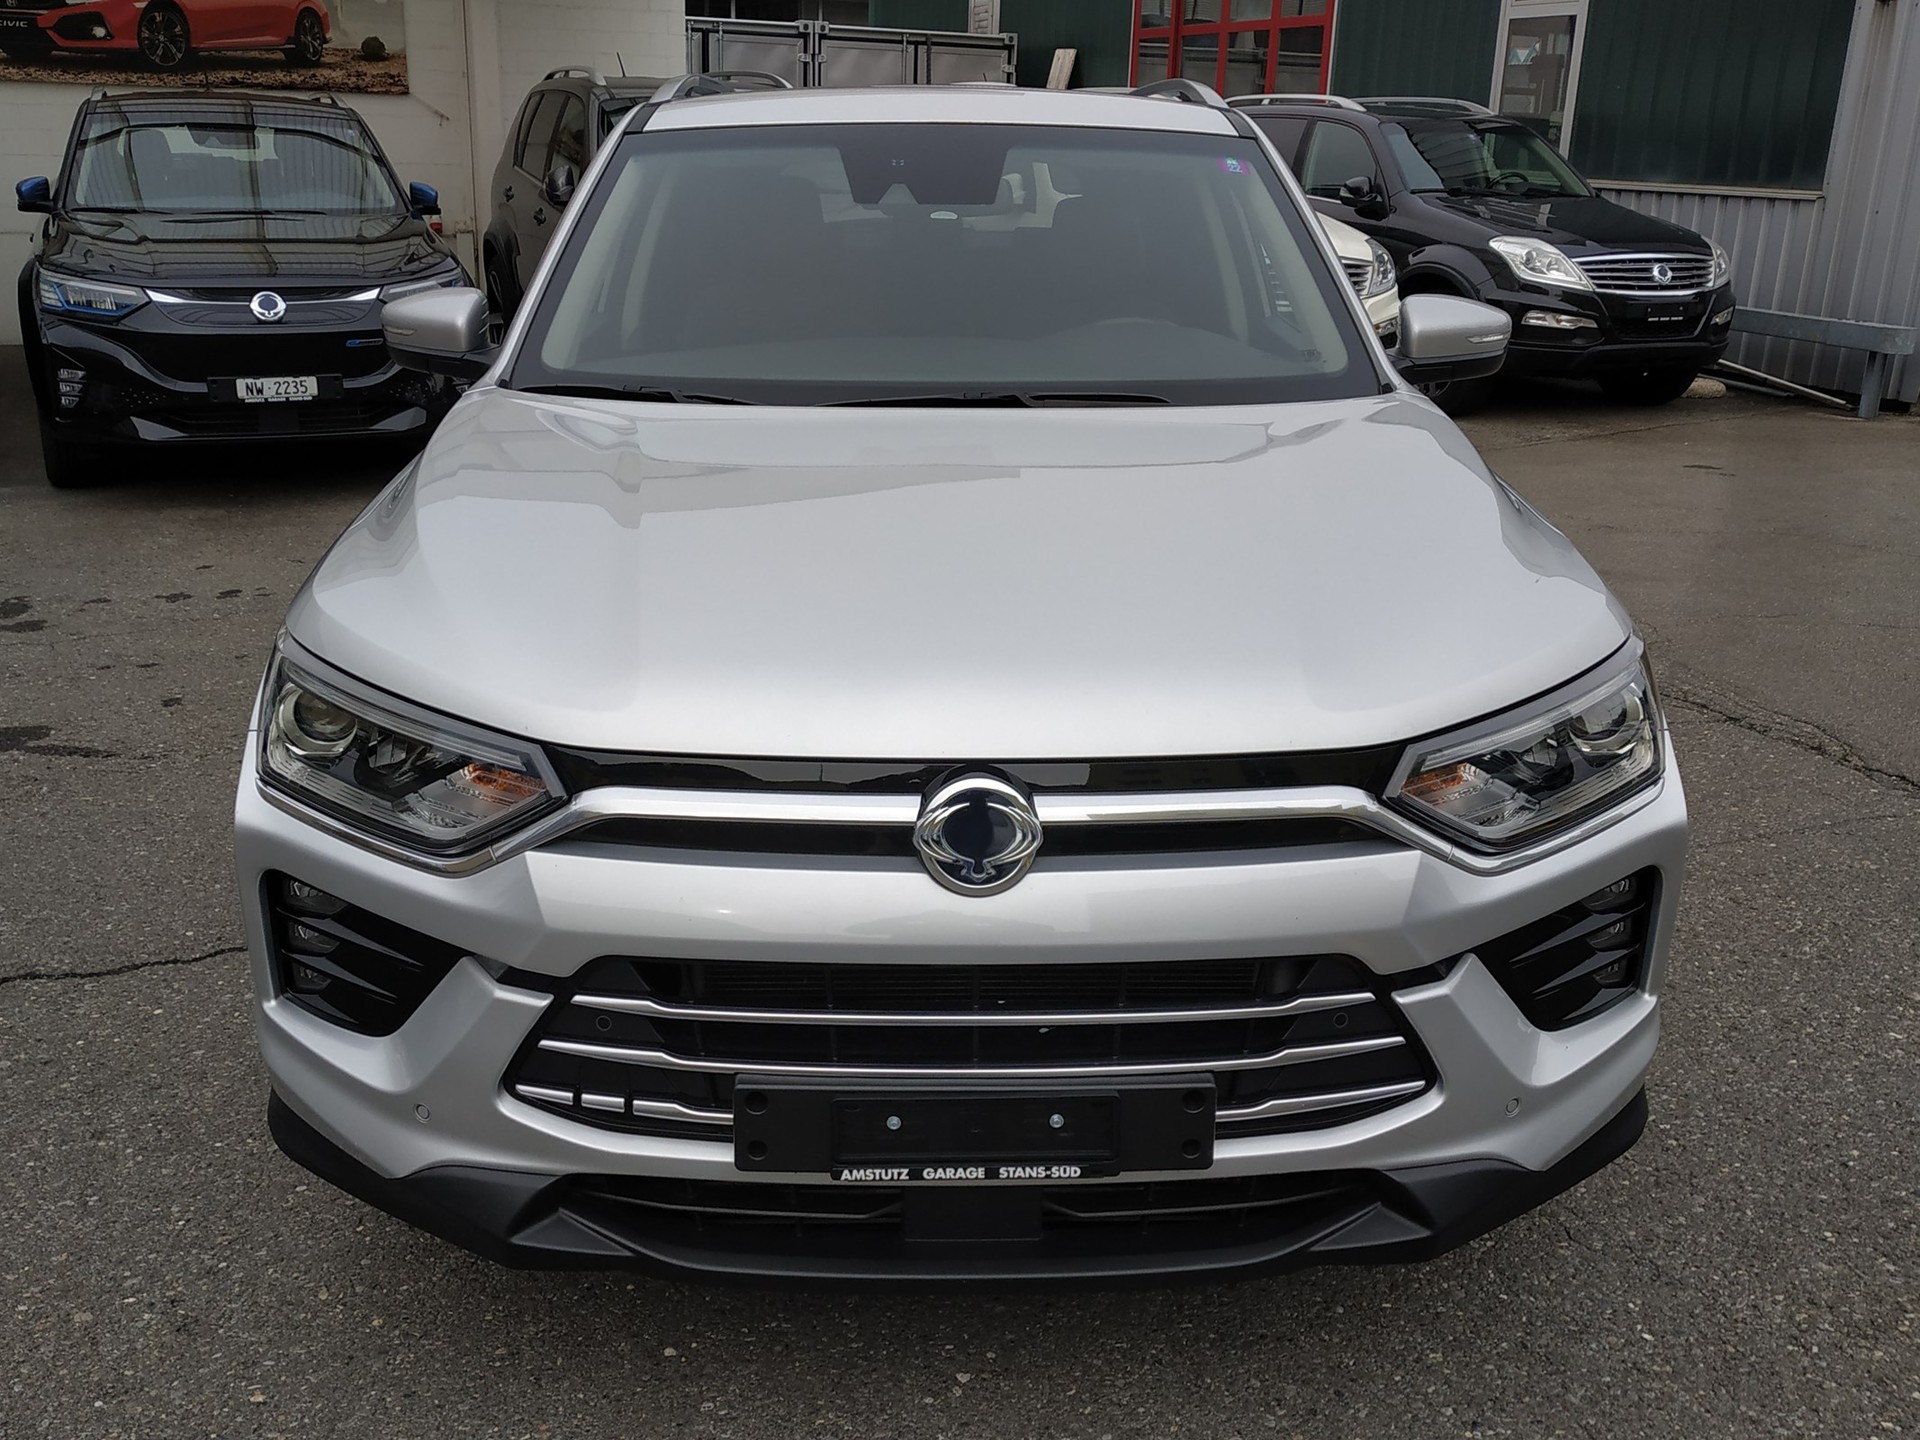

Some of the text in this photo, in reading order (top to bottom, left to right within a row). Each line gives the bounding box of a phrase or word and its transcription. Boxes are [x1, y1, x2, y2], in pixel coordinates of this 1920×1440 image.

[273, 380, 309, 395] 2235
[840, 1165, 1082, 1181] AMSTUTZ GARAGE STANS-SÜD
